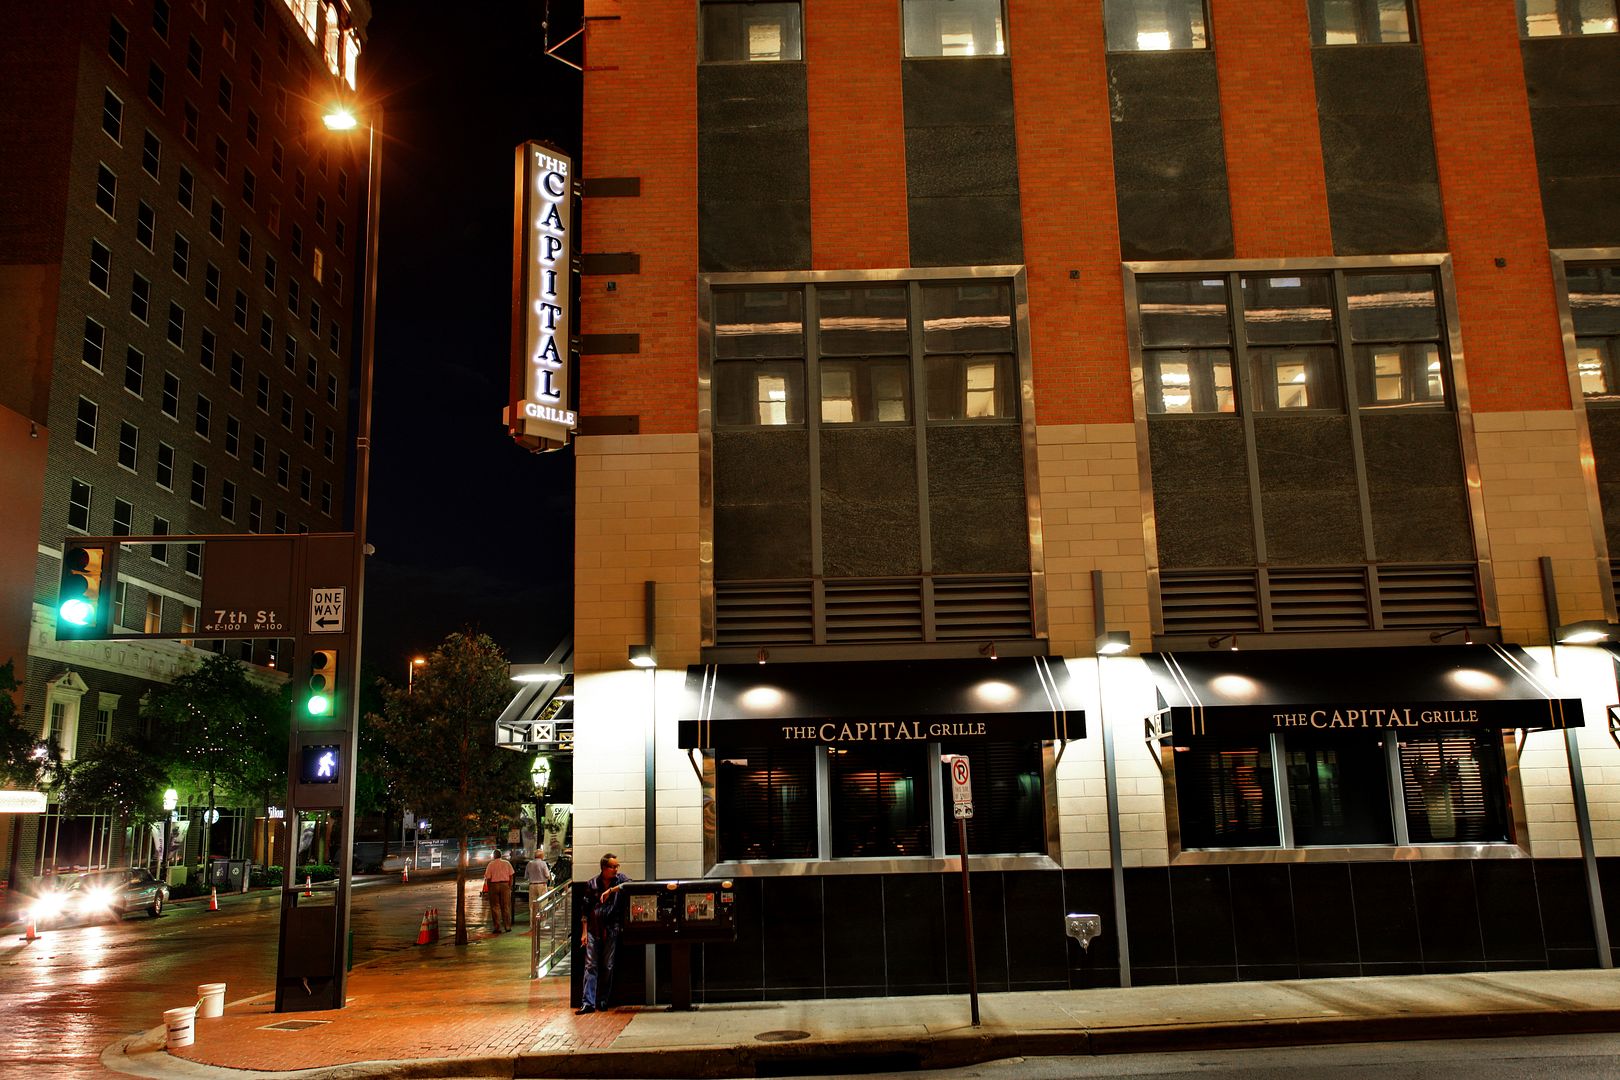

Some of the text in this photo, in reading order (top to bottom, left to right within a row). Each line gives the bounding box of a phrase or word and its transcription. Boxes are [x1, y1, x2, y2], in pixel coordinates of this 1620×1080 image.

[535, 151, 568, 176] THE
[538, 171, 566, 400] CAPITAL
[525, 403, 575, 426] GRILLE
[315, 592, 341, 604] ONE
[214, 609, 276, 624] 7th St
[314, 604, 341, 616] WAY
[214, 623, 283, 631] E-100 W-100
[1273, 708, 1479, 729] THE CAPITAL GRILLE
[782, 721, 987, 742] THE CAPITAL GRILLE
